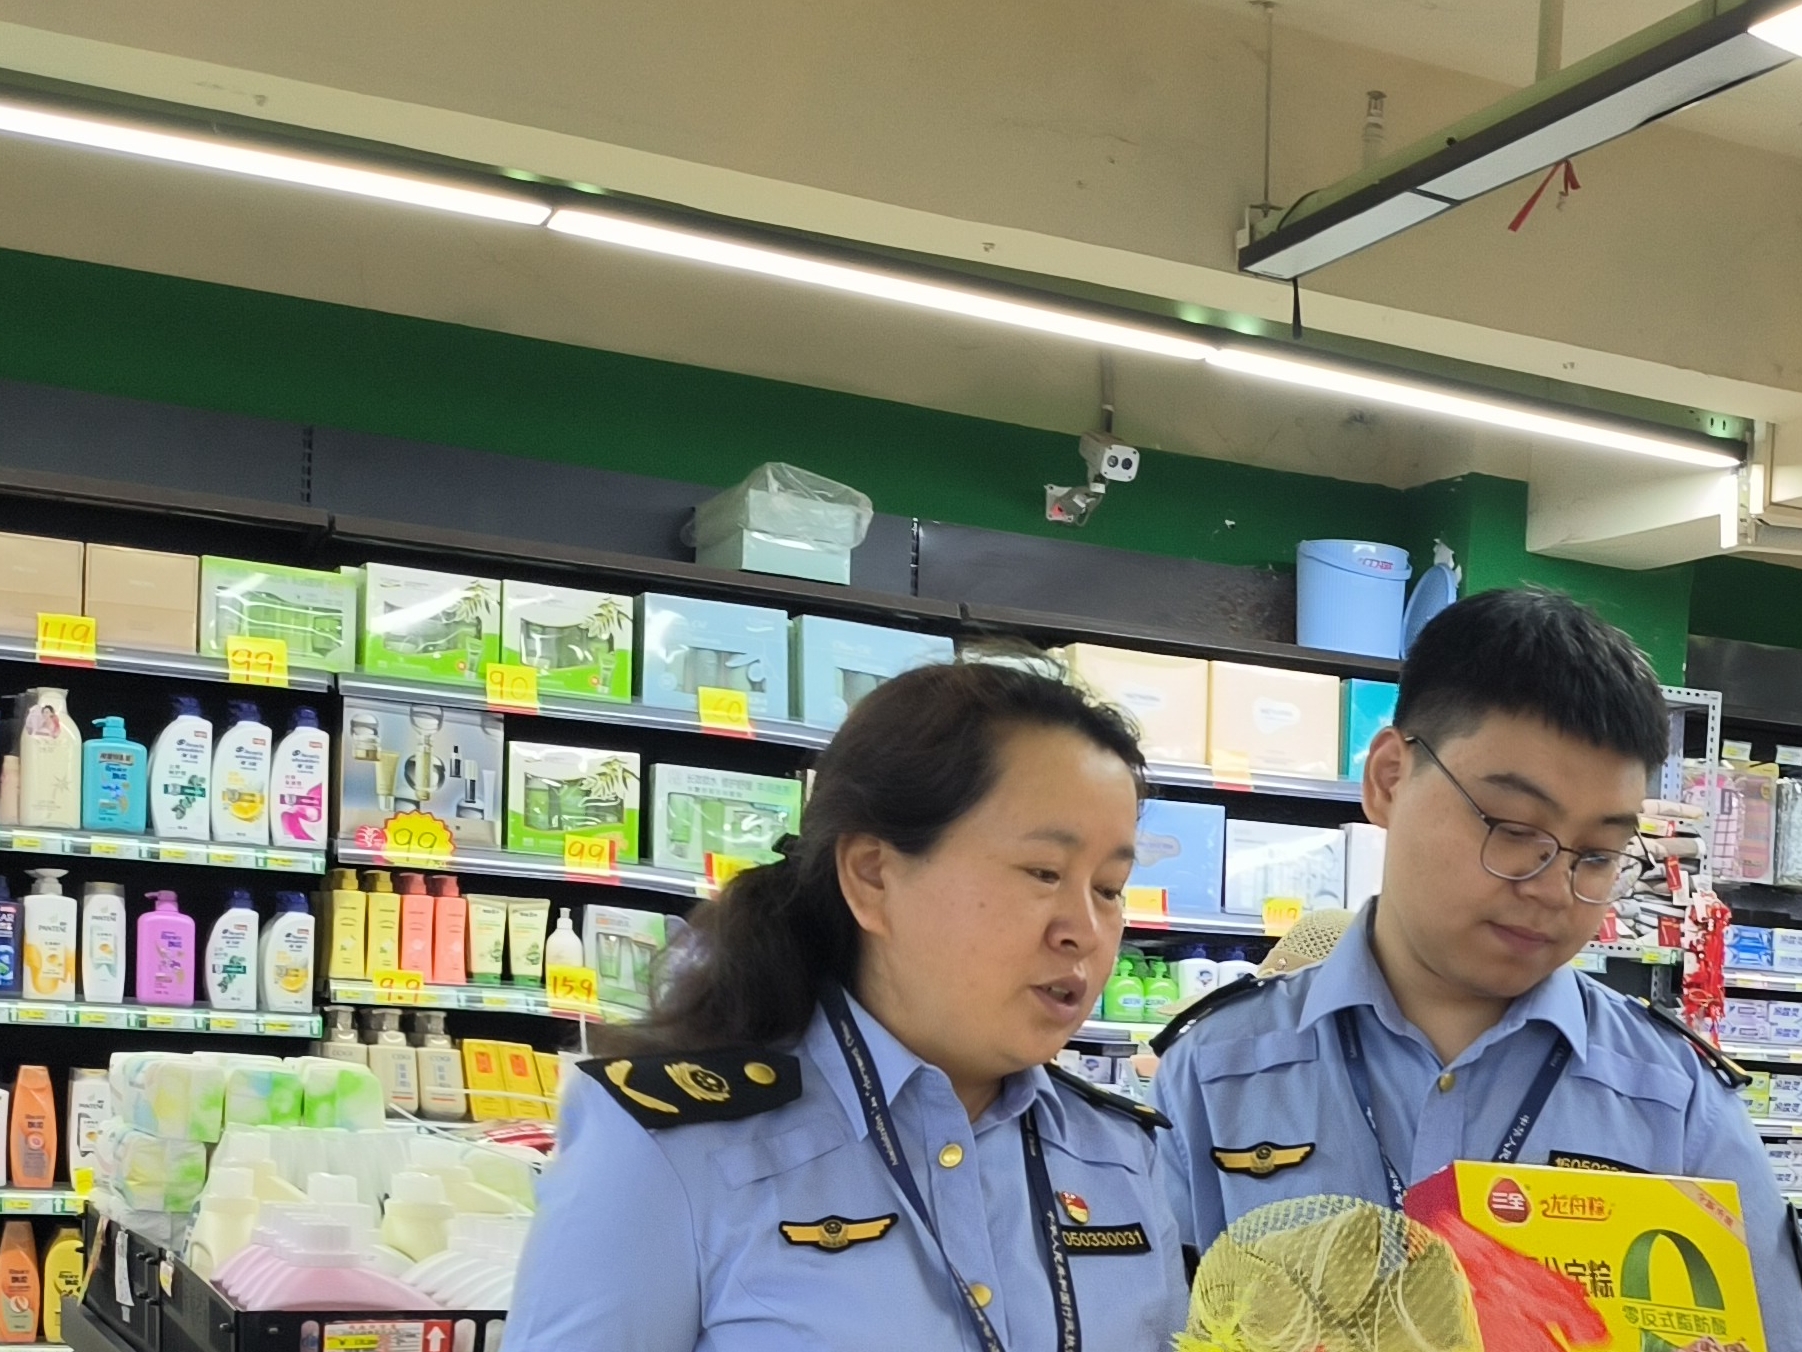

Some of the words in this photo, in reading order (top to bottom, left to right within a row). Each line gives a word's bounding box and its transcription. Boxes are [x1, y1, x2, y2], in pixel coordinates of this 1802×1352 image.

[41, 622, 92, 653] 119
[231, 649, 275, 684] 99
[489, 670, 529, 699] 90
[567, 839, 606, 868] 99
[379, 976, 422, 1004] 9.9
[1491, 1191, 1526, 1211] 三全
